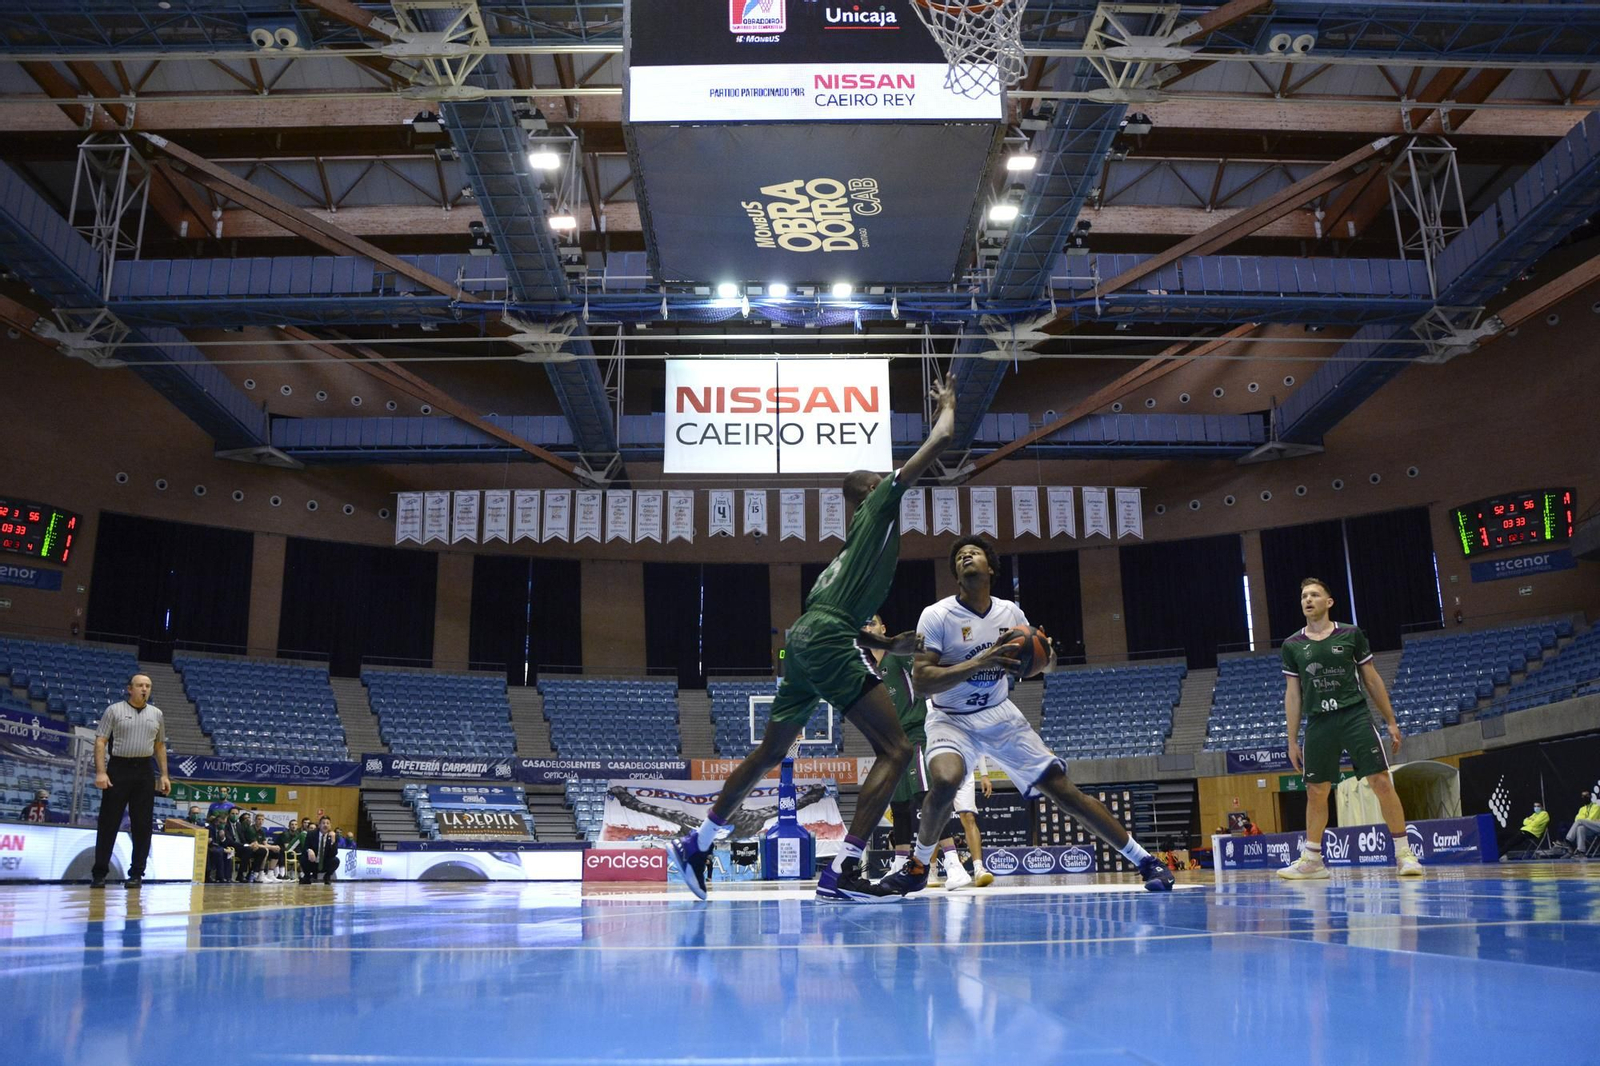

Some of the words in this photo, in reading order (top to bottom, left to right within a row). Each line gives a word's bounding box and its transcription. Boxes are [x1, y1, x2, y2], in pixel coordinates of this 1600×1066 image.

[825, 5, 897, 27] Unicaja
[814, 74, 915, 89] NISSAN
[710, 88, 740, 97] PARTIDO
[741, 88, 789, 97] PATROCINADO
[790, 88, 805, 96] POR
[814, 93, 878, 106] CAEIRO
[883, 93, 915, 106] REY
[848, 177, 882, 216] CAB
[760, 179, 822, 252] OBRA
[741, 201, 777, 249] MONBUS
[676, 386, 879, 413] NISSAN
[676, 422, 804, 445] CAEIRO
[816, 422, 880, 445] REY
[718, 506, 726, 518] 4
[752, 506, 759, 514] 15
[1506, 555, 1550, 570] cenor
[966, 692, 990, 706] 23
[1321, 698, 1338, 712] 99
[202, 760, 254, 773] MULTIUSOS
[255, 763, 291, 775] FONTES
[292, 765, 310, 775] DO
[312, 766, 330, 776] SAR
[392, 759, 440, 772] CAFETERÍA
[442, 762, 488, 774] CARPANTA
[794, 760, 852, 772] ustrum
[28, 806, 46, 822] 55
[443, 812, 458, 826] LA
[464, 812, 519, 826] PEPITA
[587, 850, 663, 869] endesa
[990, 855, 1014, 863] Estrella
[1064, 854, 1088, 862] Estrella
